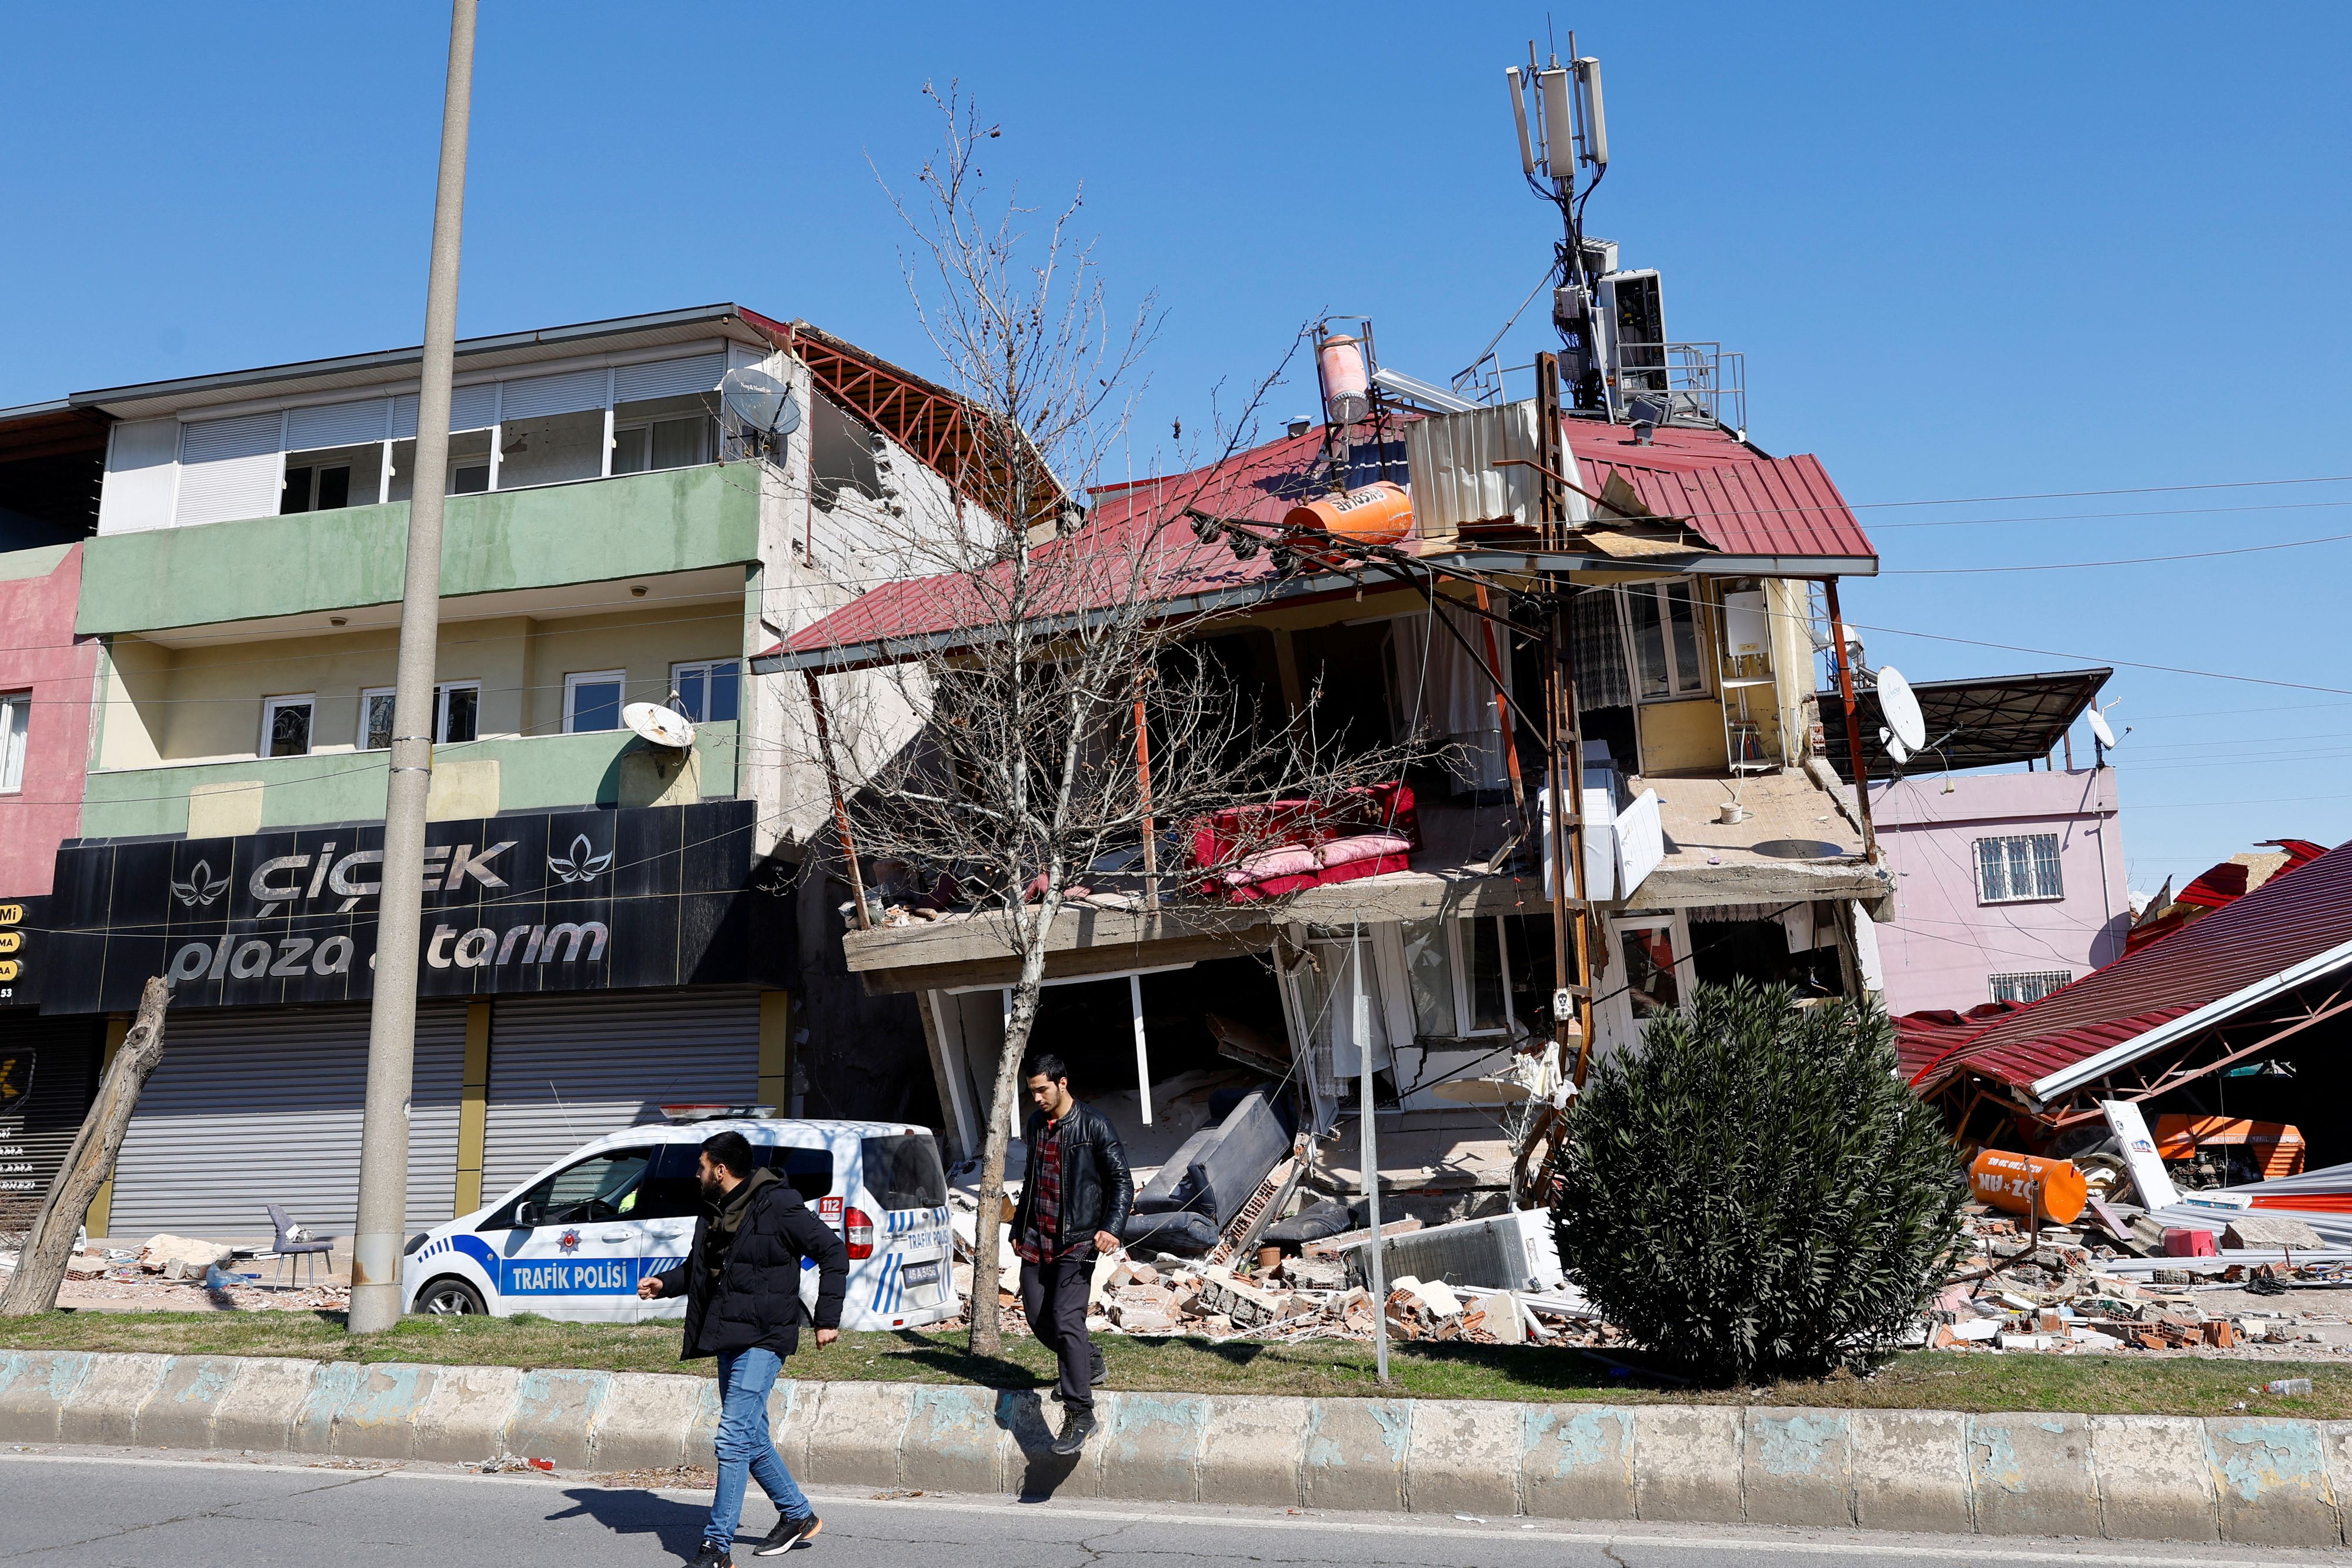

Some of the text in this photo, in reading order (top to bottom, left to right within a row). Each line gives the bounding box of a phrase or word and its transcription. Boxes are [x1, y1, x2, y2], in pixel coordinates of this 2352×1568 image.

[167, 921, 609, 988] plaza tarım
[823, 1199, 840, 1211] 112
[908, 1230, 932, 1249] TRAFİK
[513, 1261, 627, 1289] TRAFİK POLİSİ
[908, 1269, 916, 1280] 46
[917, 1268, 923, 1279] A
